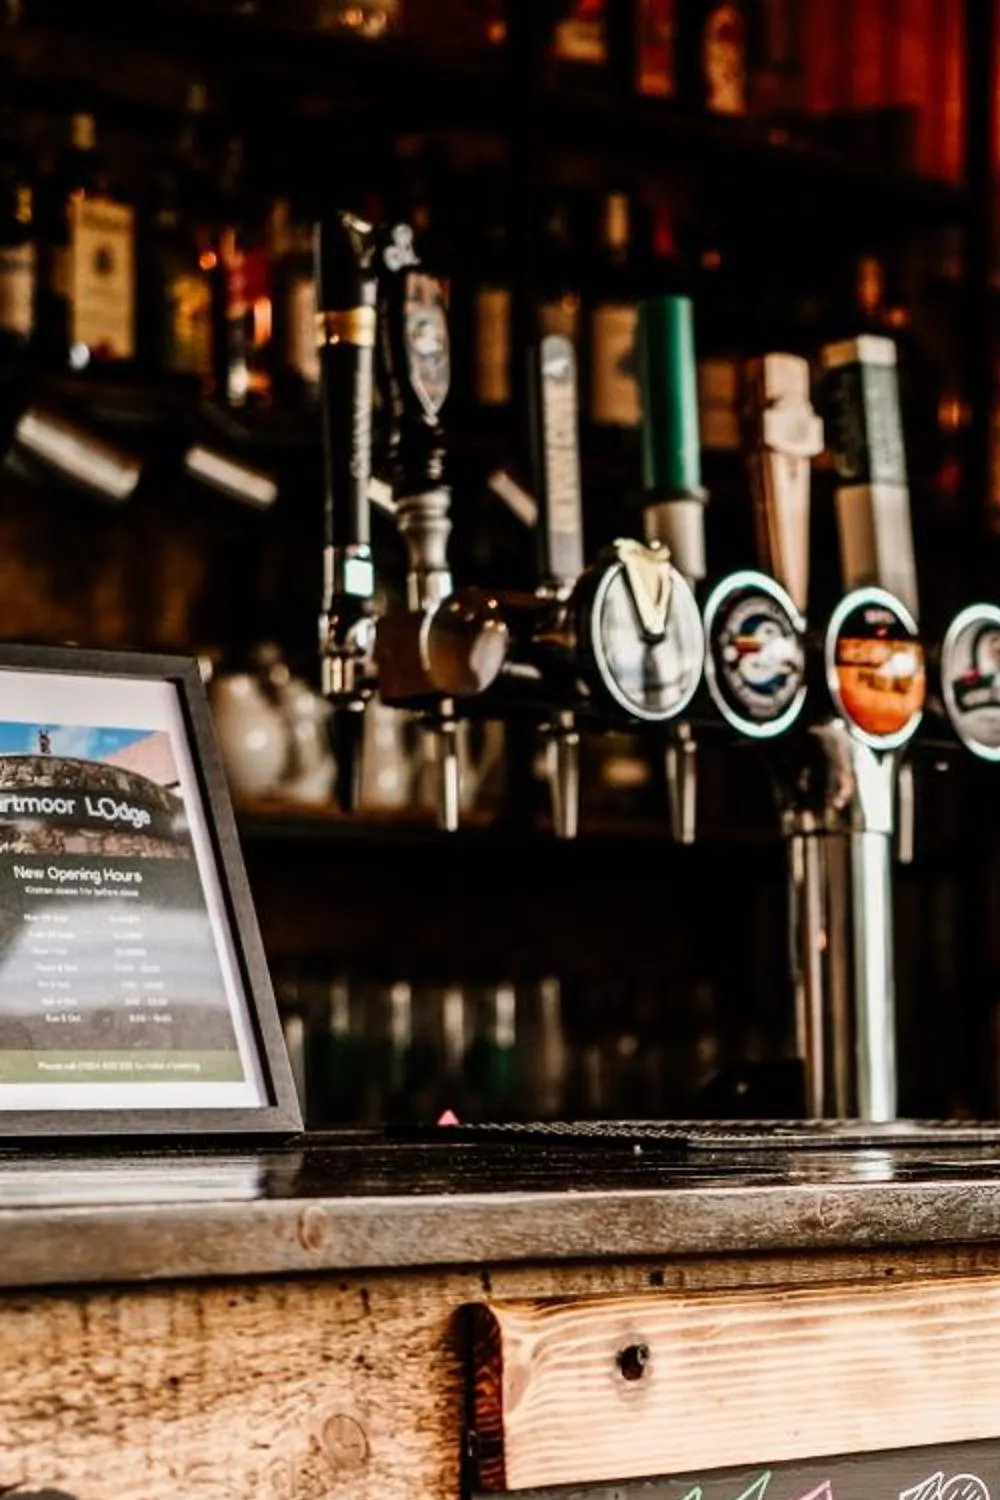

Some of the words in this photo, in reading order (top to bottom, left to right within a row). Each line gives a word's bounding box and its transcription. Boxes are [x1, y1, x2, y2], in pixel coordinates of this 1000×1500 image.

[13, 864, 44, 880] New
[48, 865, 101, 885] Opening
[104, 867, 143, 882] Hours
